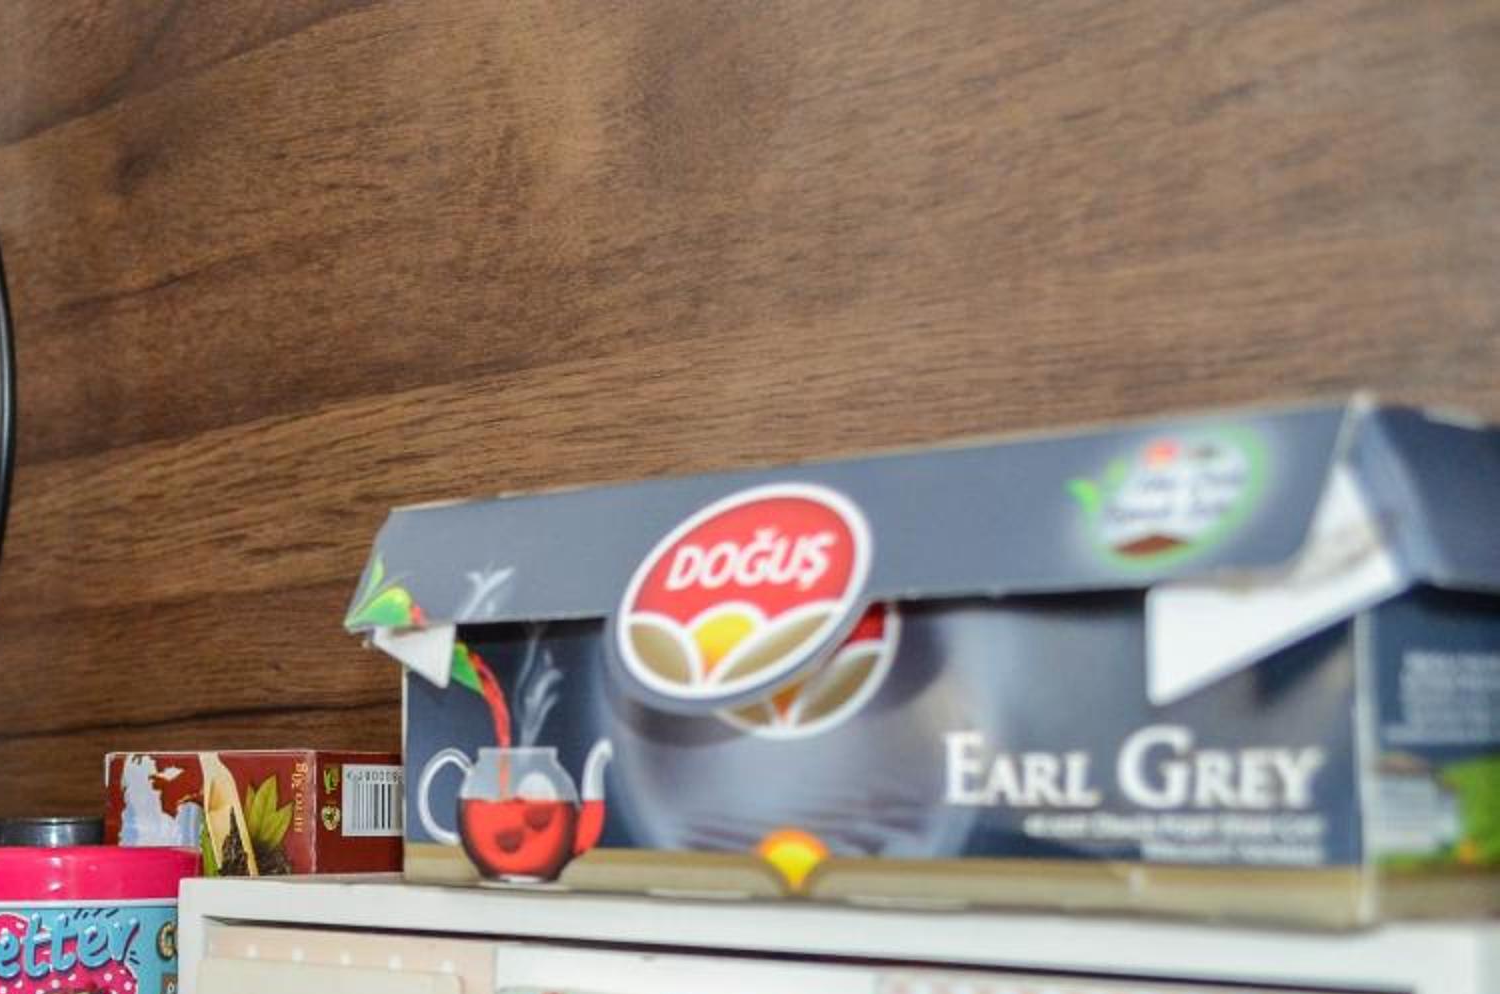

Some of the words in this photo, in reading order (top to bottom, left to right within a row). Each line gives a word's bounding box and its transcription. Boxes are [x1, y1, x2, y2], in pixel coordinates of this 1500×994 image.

[665, 526, 836, 592] DOĞUŞ
[942, 731, 1102, 808] EARL
[1116, 724, 1325, 808] GREY
